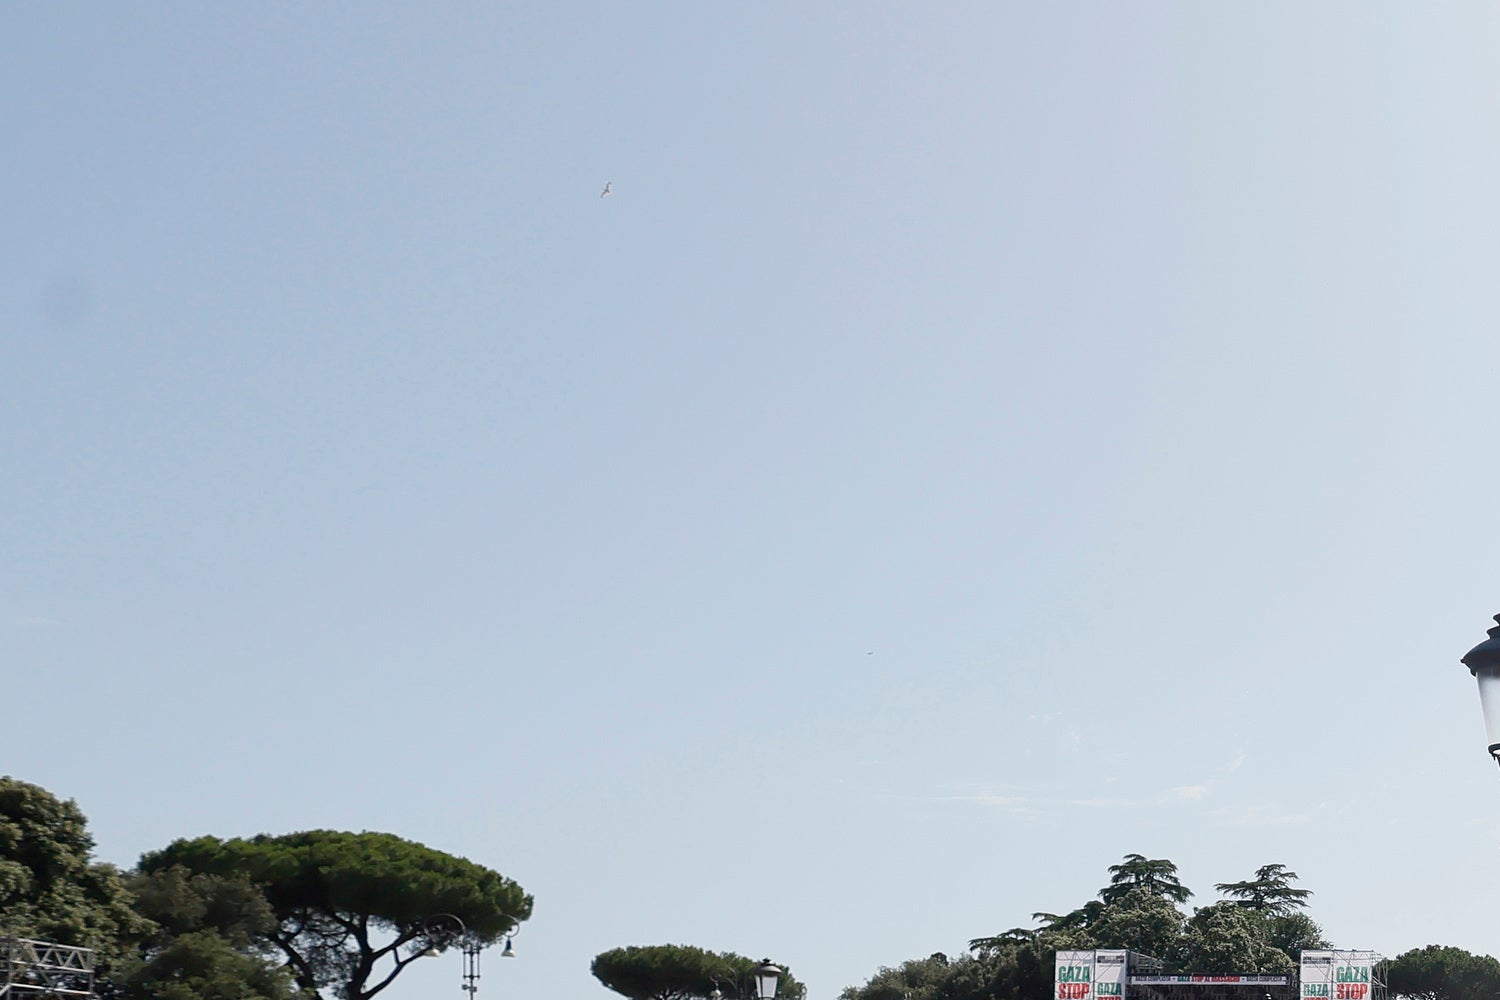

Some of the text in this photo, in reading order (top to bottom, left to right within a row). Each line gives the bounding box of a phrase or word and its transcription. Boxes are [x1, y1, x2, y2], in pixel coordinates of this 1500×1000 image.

[1059, 966, 1090, 982] GAZA
[1336, 966, 1369, 983] GAZA
[1059, 983, 1090, 999] STOP
[1097, 983, 1122, 996] GAZA
[1303, 984, 1329, 997] GAZA
[1337, 983, 1368, 1000] STOP
